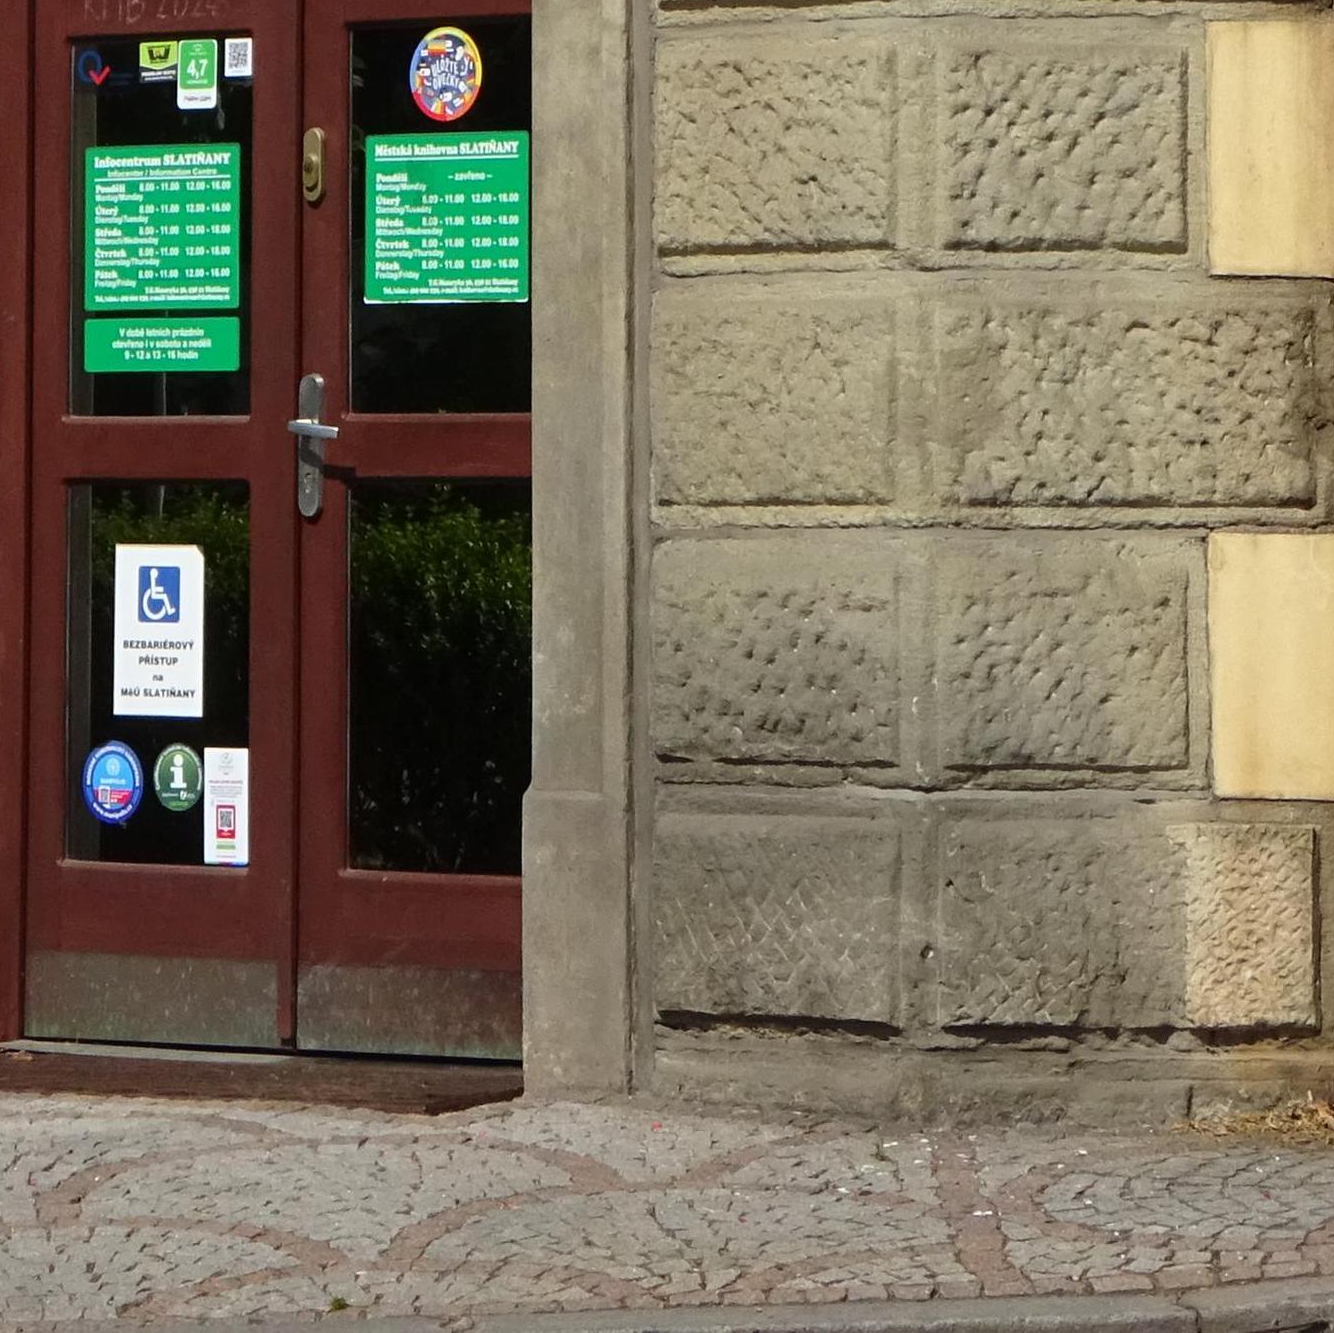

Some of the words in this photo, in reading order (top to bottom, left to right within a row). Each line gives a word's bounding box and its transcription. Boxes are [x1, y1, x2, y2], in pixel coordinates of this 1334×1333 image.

[187, 58, 208, 79] 4,7
[375, 144, 412, 157] Městská
[414, 143, 458, 155] knihovna
[459, 139, 519, 154] SLATIŇANY
[94, 157, 161, 169] Infocentrum
[163, 151, 231, 166] SLATIŇANY
[123, 637, 194, 651] BEZBARIÉROVÝ
[138, 654, 178, 667] PŘÍSTUP
[153, 674, 164, 683] na
[143, 685, 196, 699] SLATIŇANY
